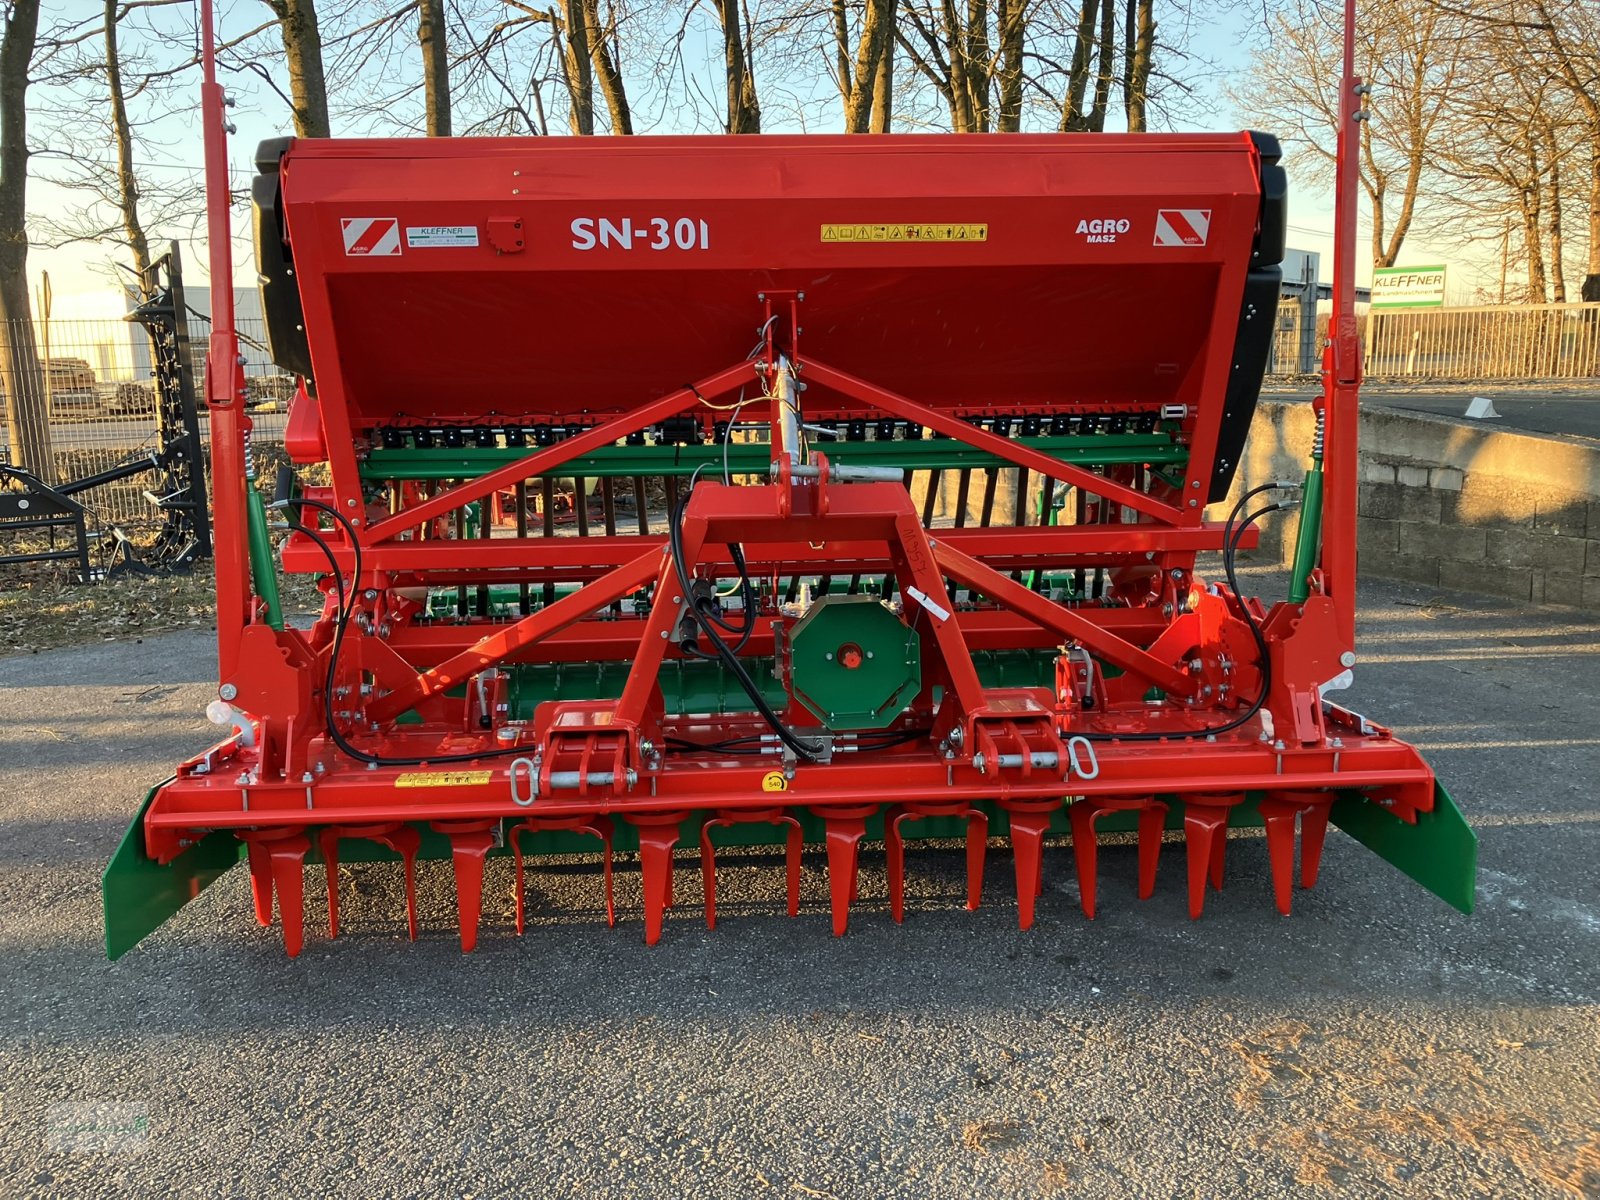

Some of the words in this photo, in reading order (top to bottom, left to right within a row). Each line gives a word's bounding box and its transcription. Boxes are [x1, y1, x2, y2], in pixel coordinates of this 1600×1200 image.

[421, 227, 463, 235] KLEFFNER
[1075, 218, 1130, 234] AGRO
[570, 217, 709, 250] SN-301
[1086, 234, 1116, 243] MASZ
[1374, 275, 1442, 287] KLEFFNER
